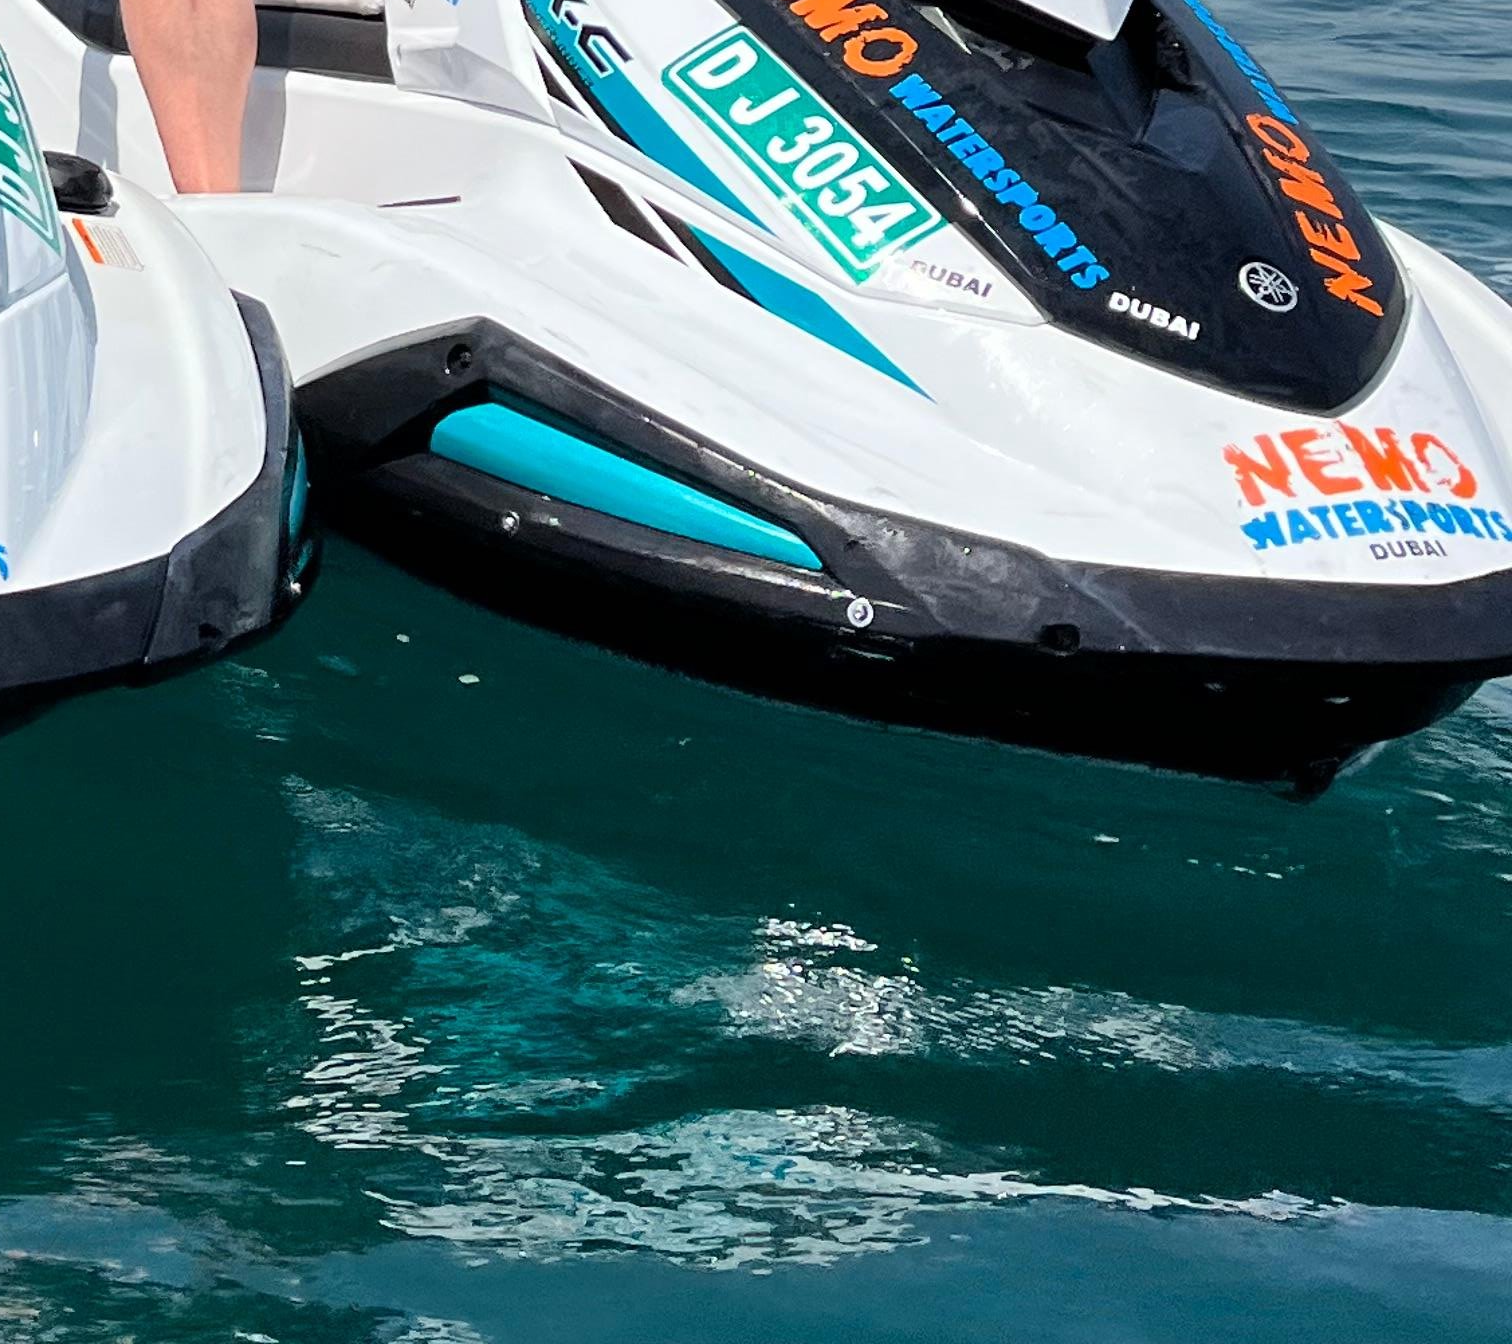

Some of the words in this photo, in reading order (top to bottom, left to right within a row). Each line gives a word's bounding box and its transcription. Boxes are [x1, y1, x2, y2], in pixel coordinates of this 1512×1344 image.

[766, 116, 917, 248] 3054
[889, 73, 1110, 289] WATERSPORTS
[1109, 291, 1200, 340] DUBAI
[1246, 113, 1385, 317] NEMO
[1222, 419, 1479, 507] NEMO
[1240, 498, 1512, 550] WATERSPORTS
[1370, 540, 1447, 561] DUBAI
